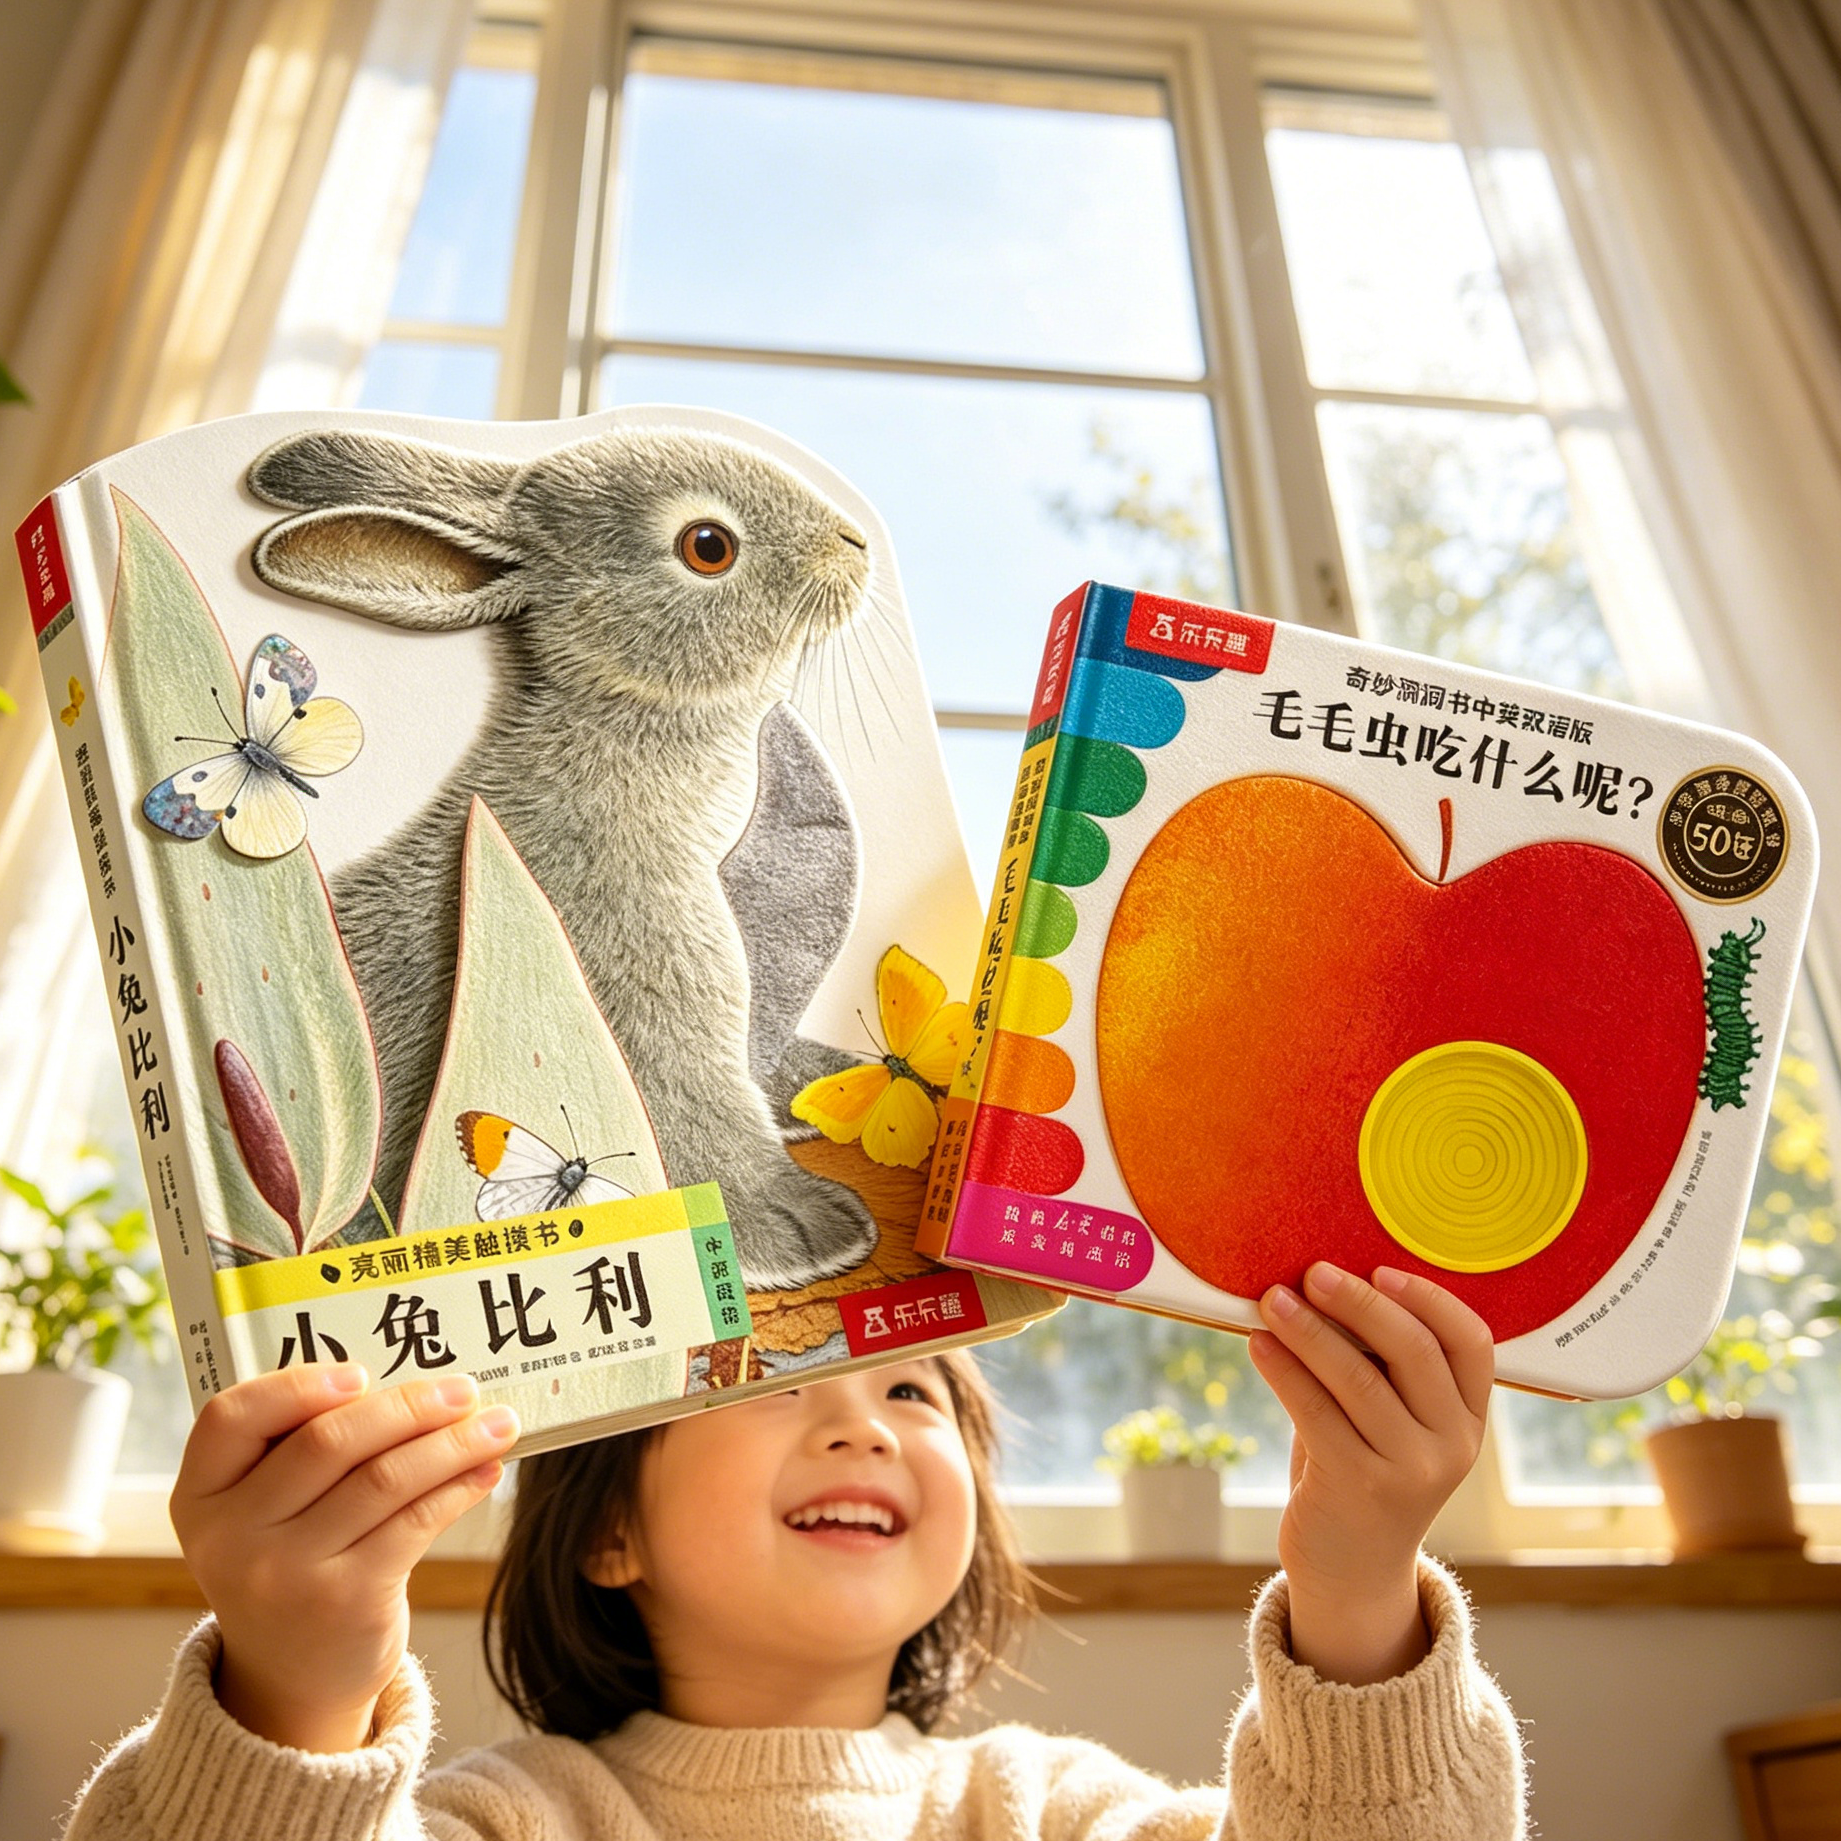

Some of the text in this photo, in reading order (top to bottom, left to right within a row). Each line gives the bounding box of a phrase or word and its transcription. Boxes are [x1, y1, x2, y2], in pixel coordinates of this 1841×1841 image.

[1252, 689, 1654, 819] 毛毛虫吃什么呢?
[109, 915, 171, 1140] 小兔比利
[276, 1251, 653, 1380] 小兔比利
